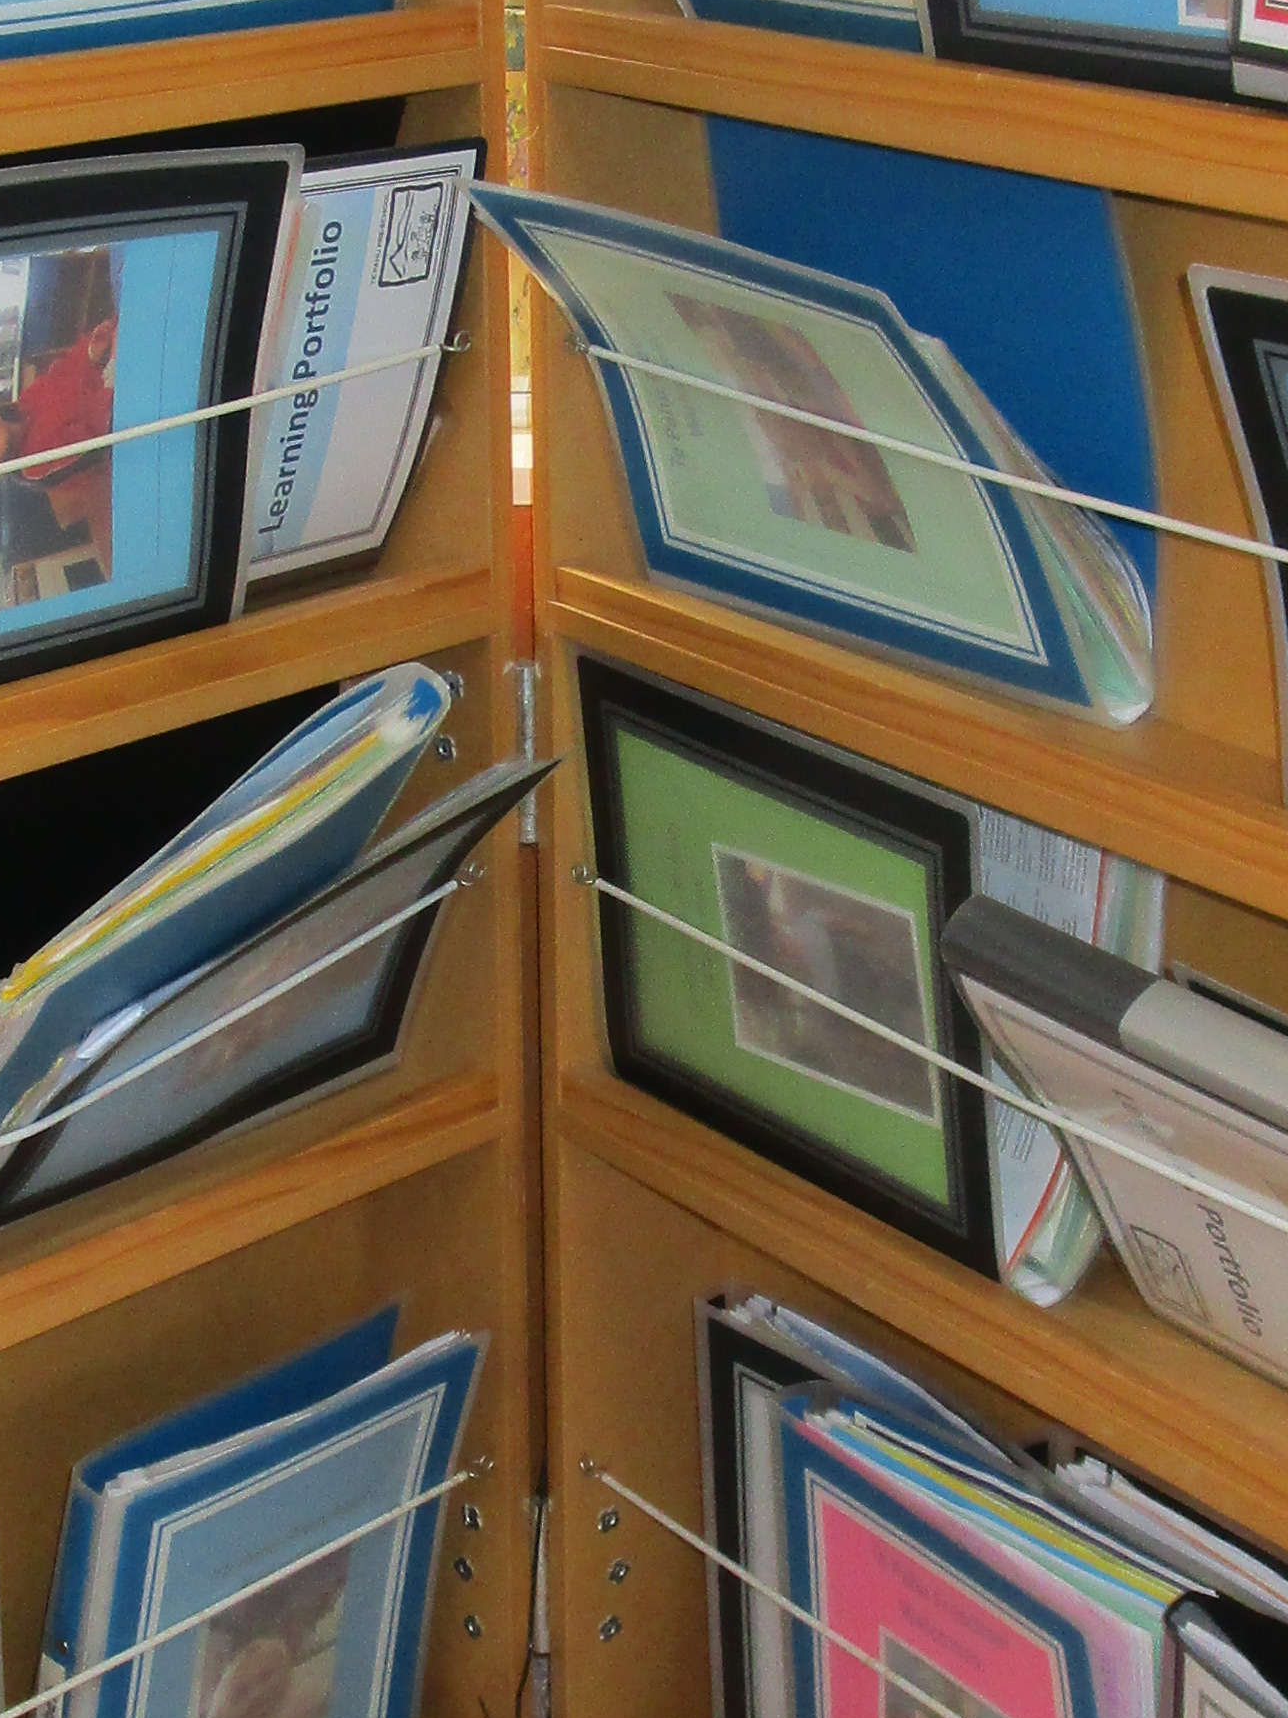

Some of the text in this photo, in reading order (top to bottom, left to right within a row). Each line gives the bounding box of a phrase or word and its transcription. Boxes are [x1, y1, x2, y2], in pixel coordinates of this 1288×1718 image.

[258, 218, 344, 537] Learning Portfolio
[1195, 1203, 1264, 1338] Portfolio
